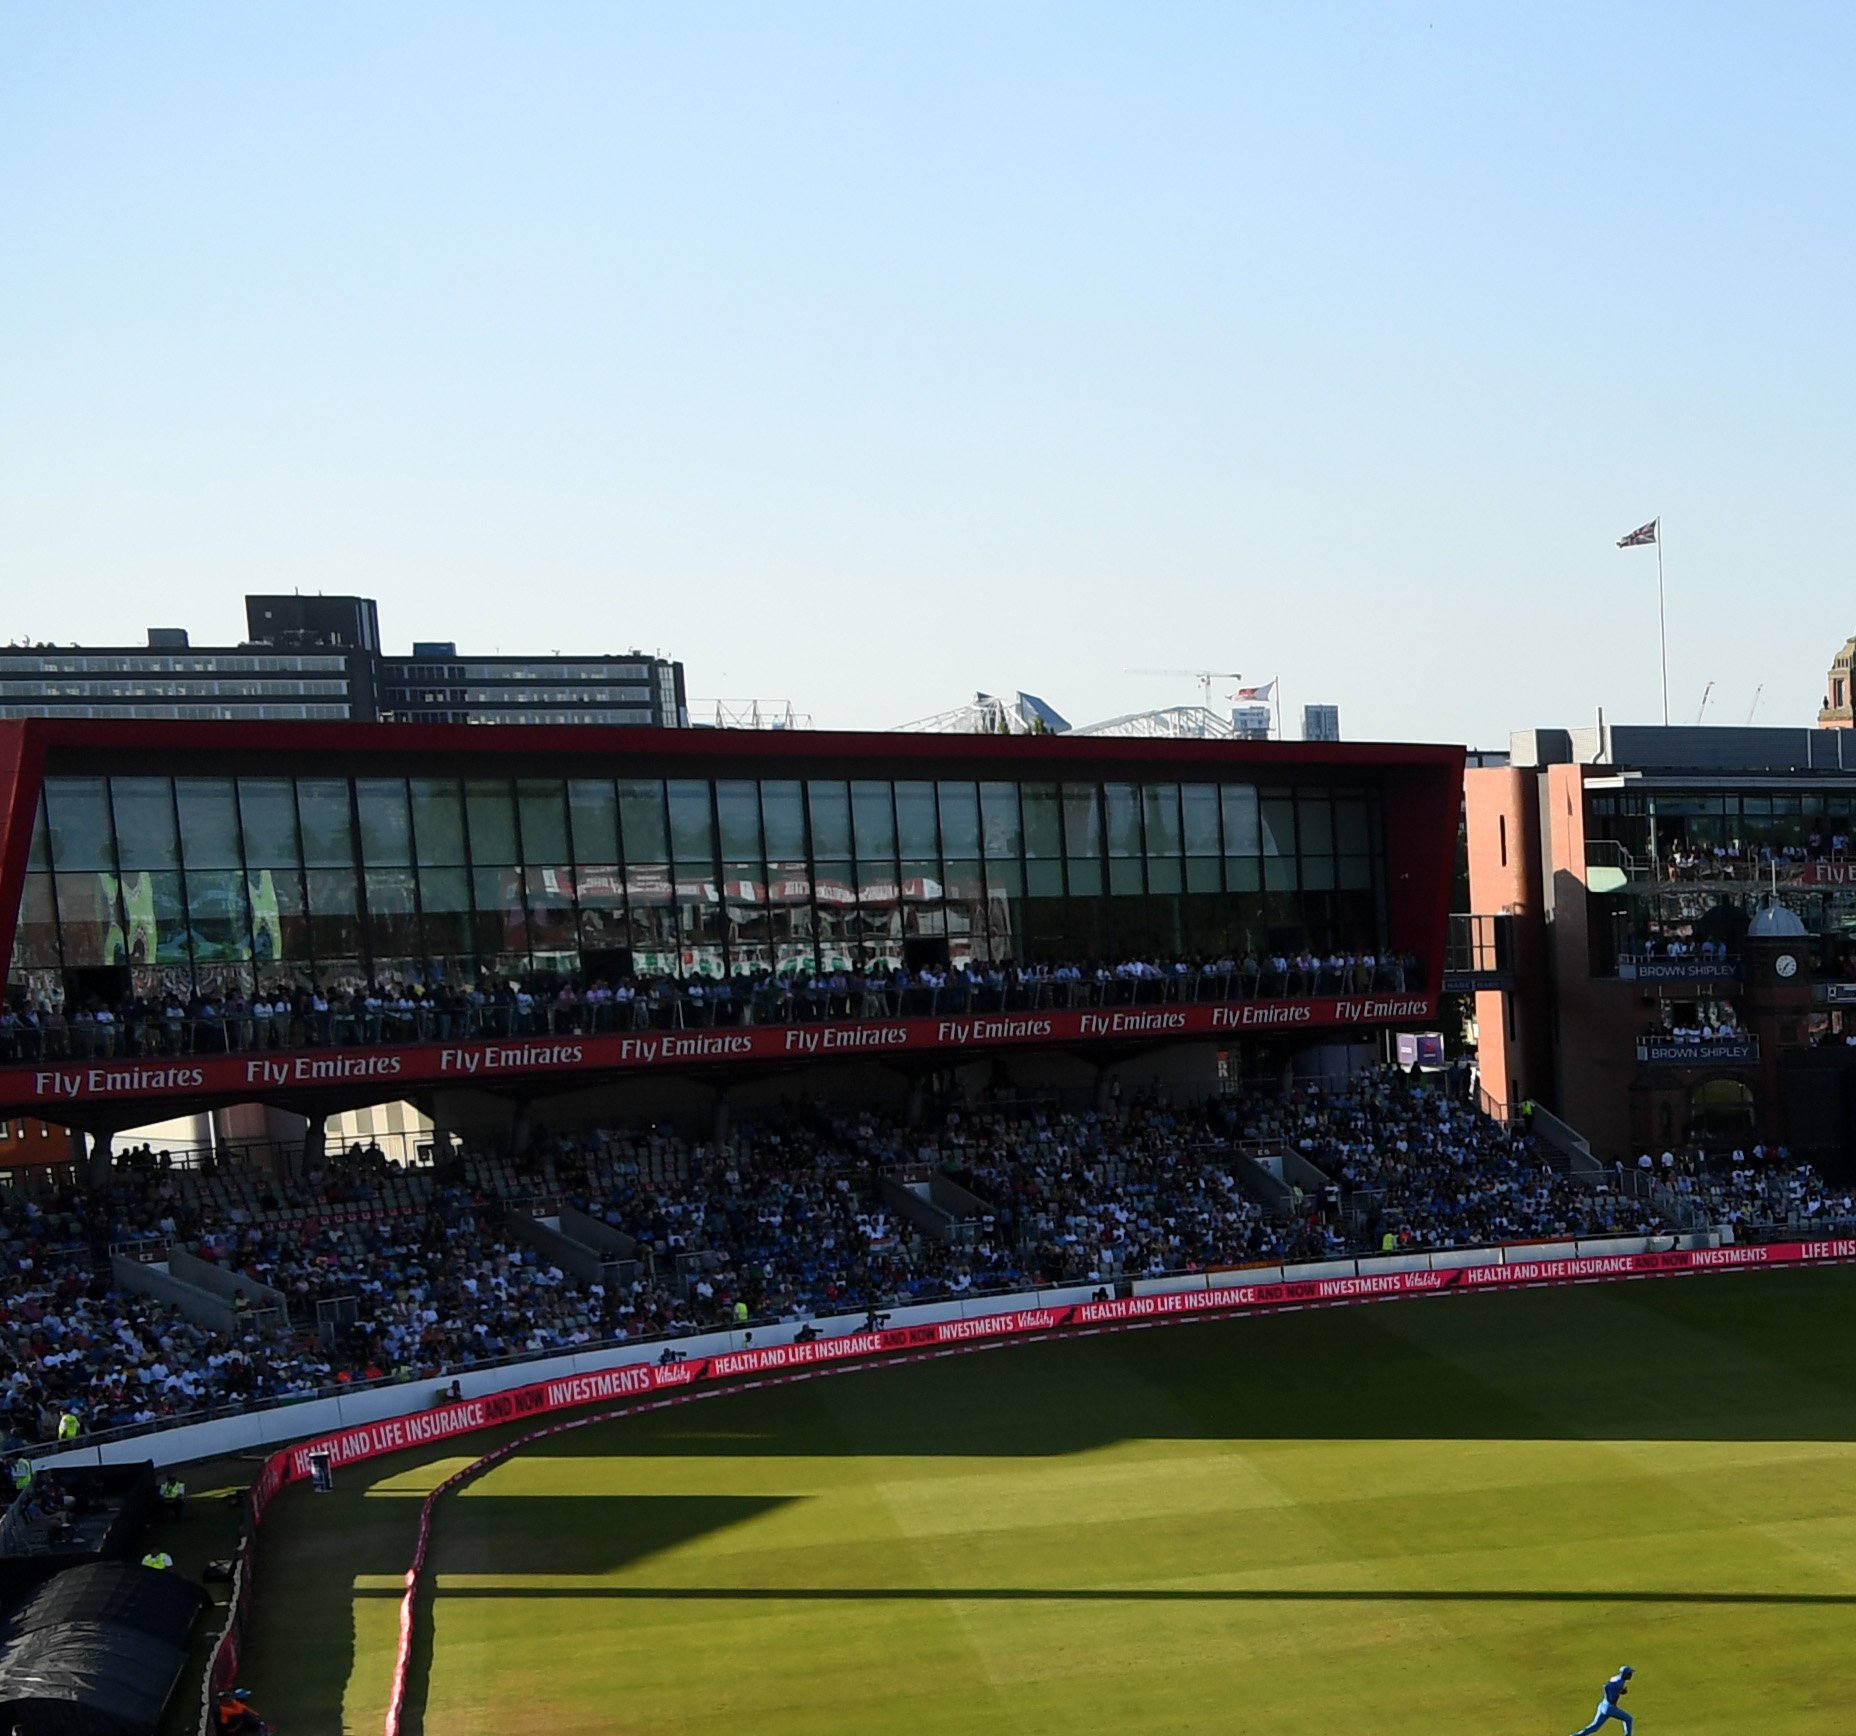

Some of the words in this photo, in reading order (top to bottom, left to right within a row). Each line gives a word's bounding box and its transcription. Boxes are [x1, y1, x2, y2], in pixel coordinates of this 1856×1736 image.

[1816, 864, 1841, 883] Fly
[1640, 965, 1686, 978] BROWN
[1689, 964, 1736, 977] SHIPLEY
[1079, 1013, 1109, 1035] Fly
[1113, 1010, 1186, 1030] Emirates
[1213, 1007, 1239, 1027] Fly
[1242, 1005, 1310, 1023] Emirates
[1336, 1001, 1362, 1021] Fly
[1364, 999, 1428, 1017] Emirates
[785, 1030, 818, 1052] Fly
[823, 1026, 907, 1047] Emirates
[938, 1022, 969, 1044] Fly
[973, 1018, 1051, 1039] Emirates
[441, 1049, 479, 1073] Fly
[485, 1045, 583, 1066] Emirates
[621, 1040, 657, 1062] Fly
[663, 1035, 752, 1056] Emirates
[1652, 1047, 1698, 1059] BROWN
[1700, 1046, 1748, 1058] SHIPLEY
[36, 1071, 81, 1097] Fly
[87, 1068, 203, 1091] Emirates
[246, 1061, 288, 1085] Fly
[296, 1057, 400, 1078] Emirates
[1802, 1242, 1830, 1259] LIFE
[1468, 1268, 1510, 1282] HEALTH
[1514, 1266, 1539, 1278] AND
[1542, 1264, 1565, 1276] LIFE
[1568, 1258, 1633, 1274] INSURANCE
[1692, 1248, 1767, 1265] INVESTMENTS
[1405, 1270, 1441, 1287] Vitality
[1082, 1303, 1125, 1321] HEALTH
[1129, 1300, 1154, 1315] AND
[1159, 1297, 1181, 1311] LIFE
[1184, 1289, 1255, 1309] INSURANCE
[1319, 1273, 1400, 1295] INVESTMENTS
[1018, 1311, 1054, 1328] Vitality
[715, 1353, 757, 1374] HEALTH
[761, 1348, 785, 1366] AND
[789, 1345, 812, 1362] LIFE
[815, 1335, 880, 1359] INSURANCE
[939, 1316, 1013, 1339] INVESTMENTS
[654, 1364, 691, 1384] Vitality
[342, 1436, 369, 1460] AND
[374, 1423, 403, 1451] LIFE
[405, 1403, 483, 1441] INSURANCE
[548, 1369, 649, 1406] INVESTMENTS
